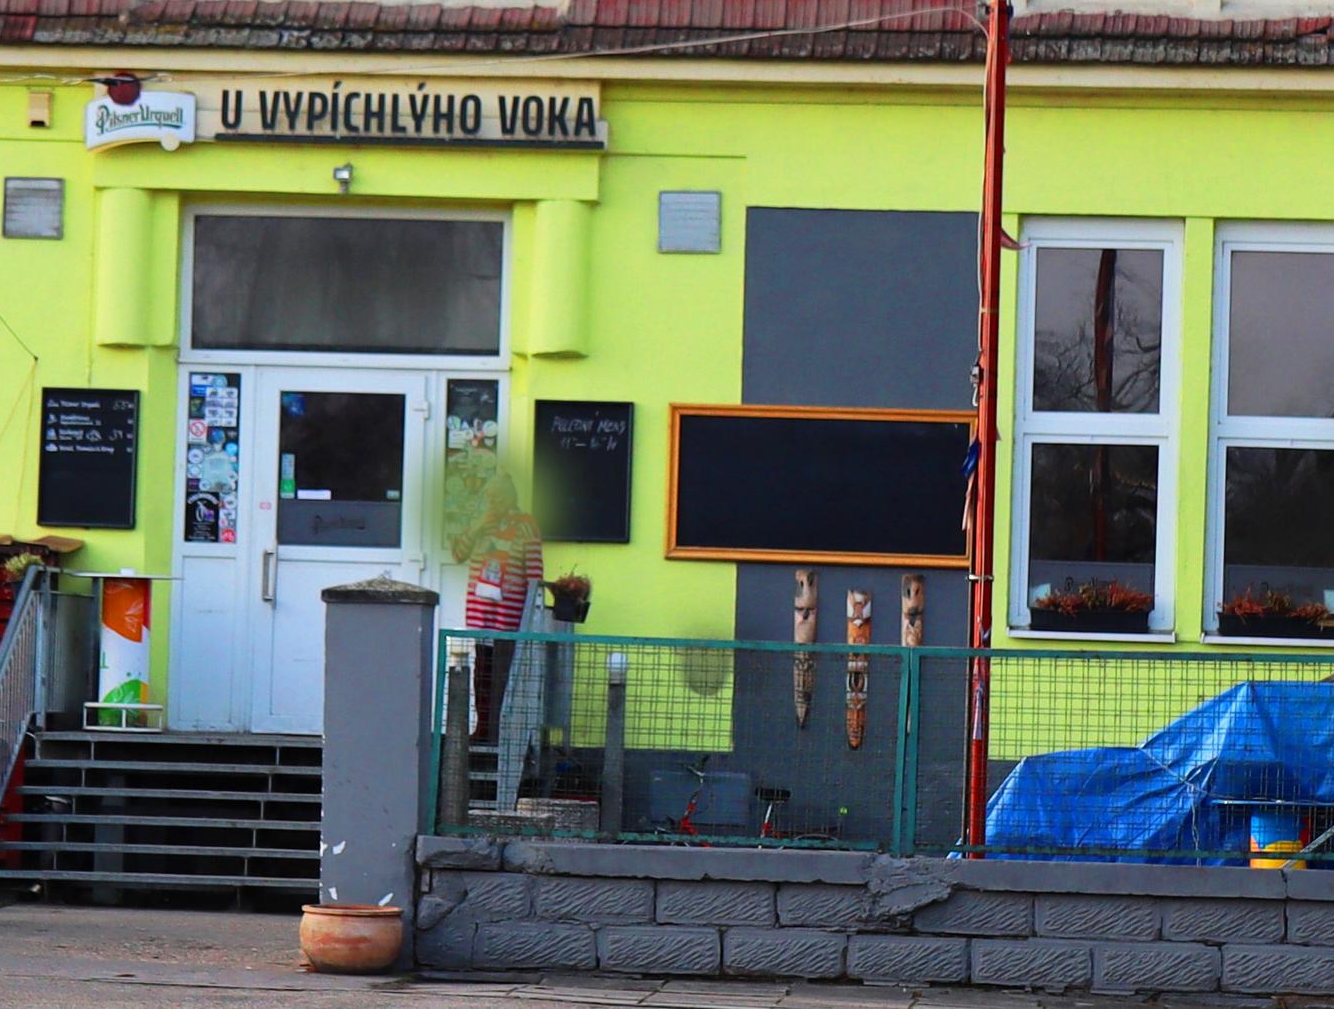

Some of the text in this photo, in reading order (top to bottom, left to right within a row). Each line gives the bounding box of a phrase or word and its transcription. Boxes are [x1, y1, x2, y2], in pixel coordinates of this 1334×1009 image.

[220, 81, 597, 137] U VYPÍCHLÝHO VOKA
